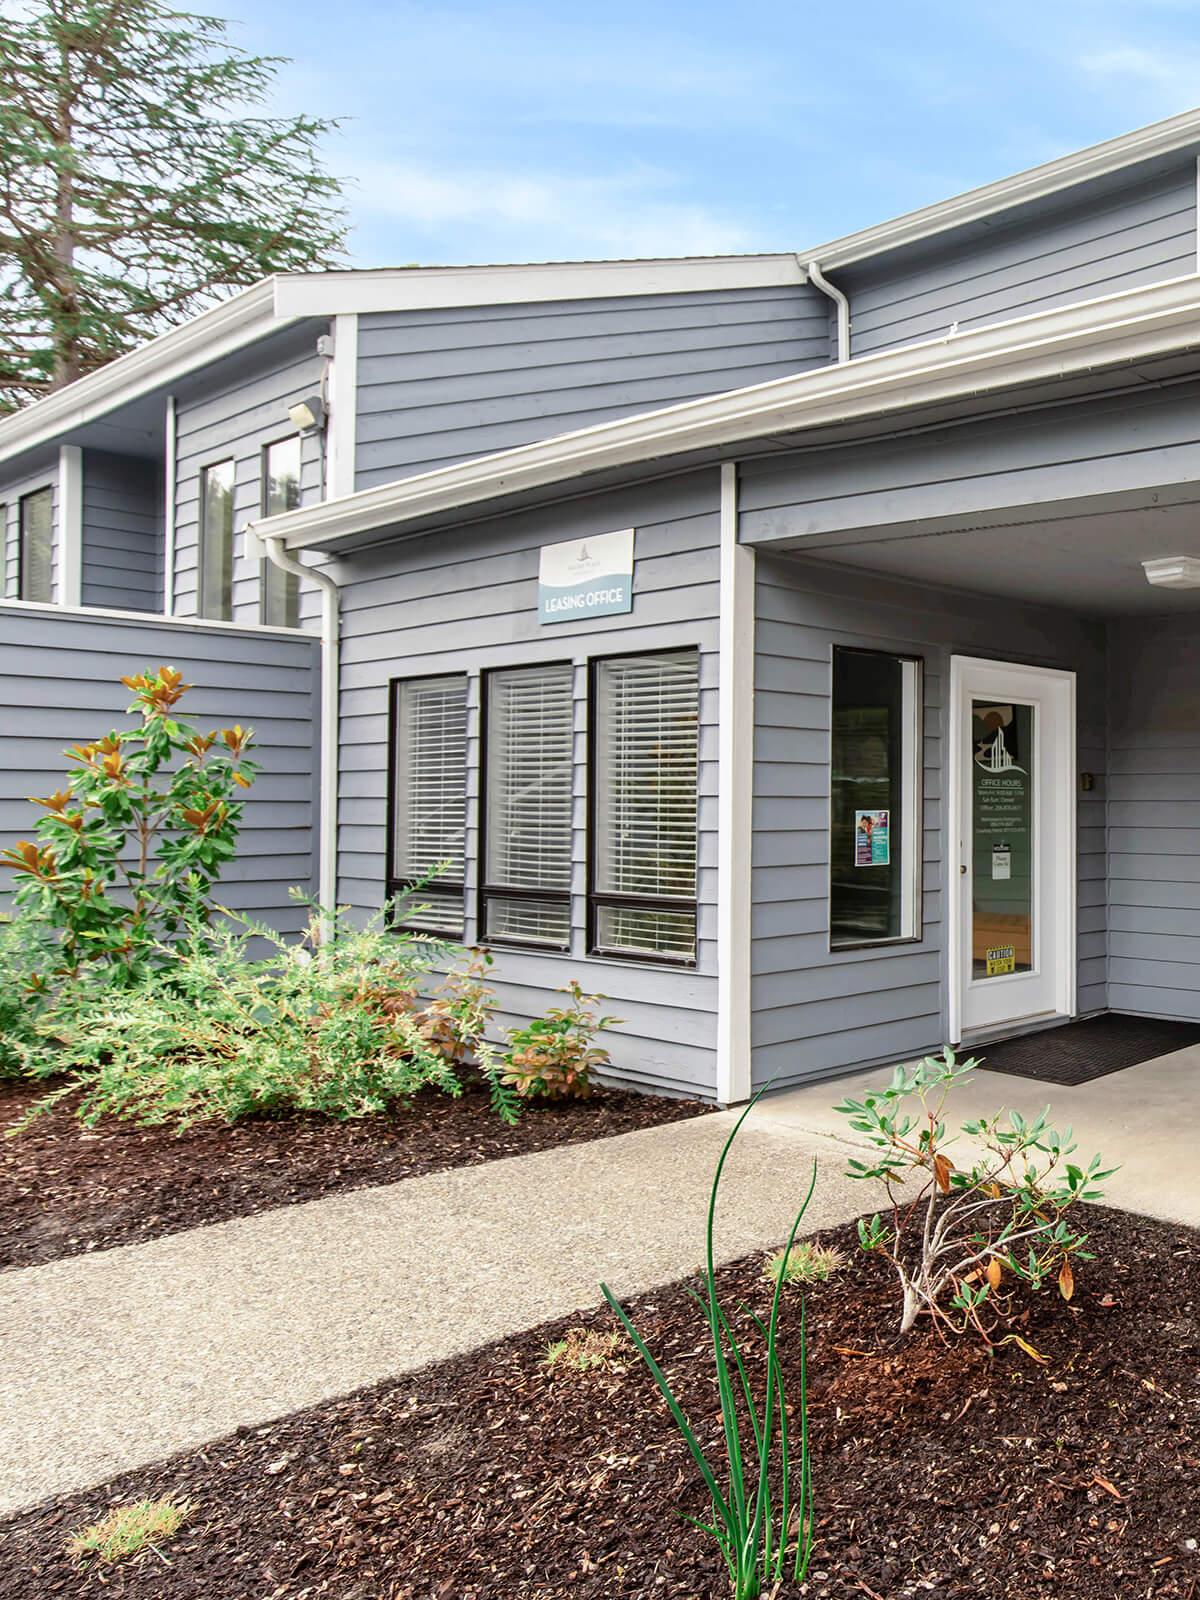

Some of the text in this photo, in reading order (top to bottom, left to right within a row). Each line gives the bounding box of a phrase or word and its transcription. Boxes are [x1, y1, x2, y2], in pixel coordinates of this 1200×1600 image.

[545, 588, 624, 613] LEASING OFFICE
[988, 948, 1012, 960] CAUTION
